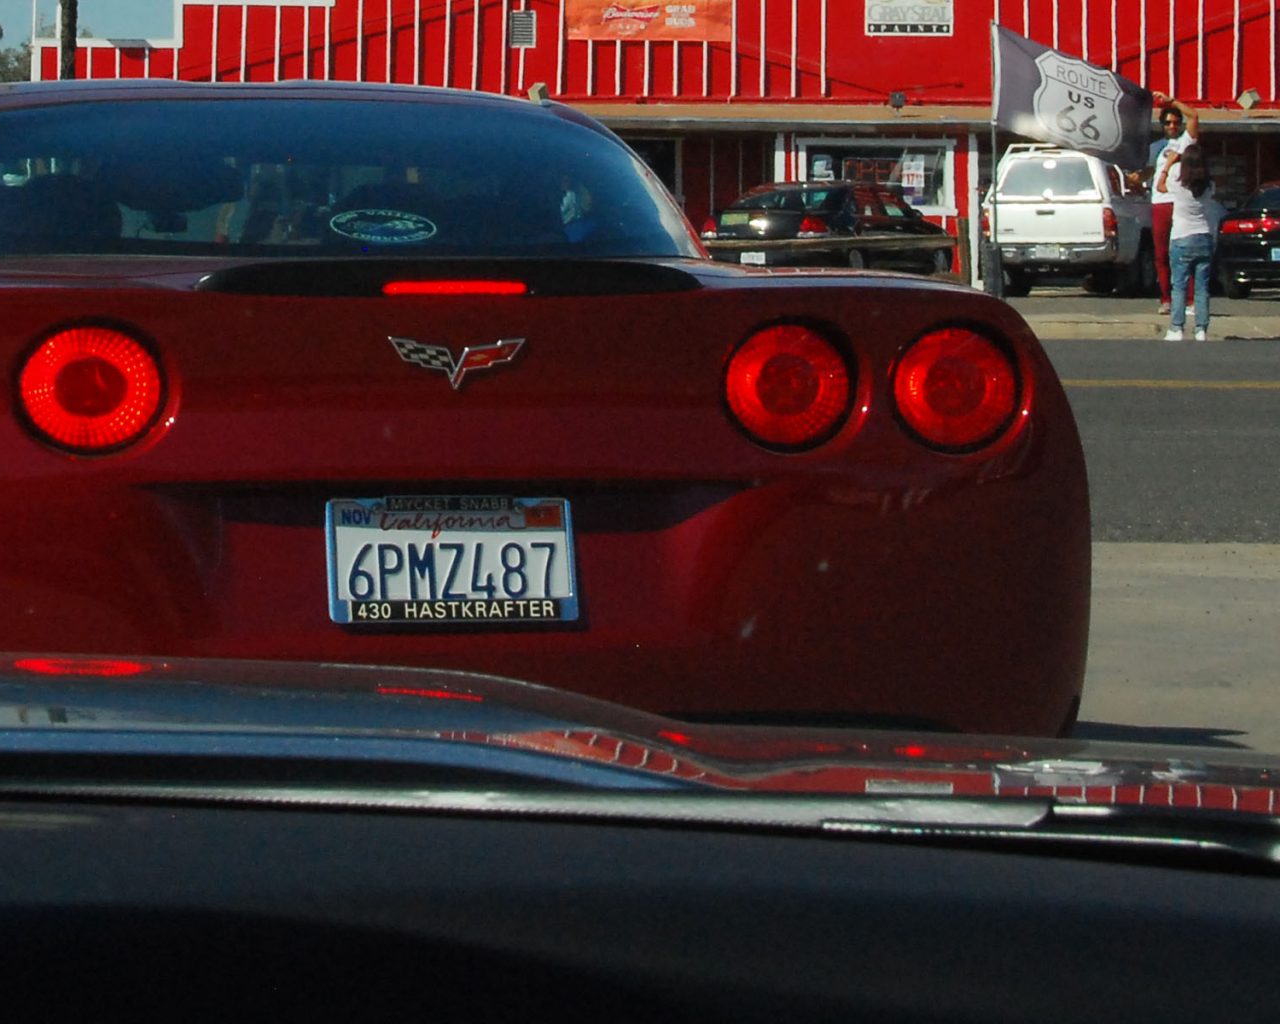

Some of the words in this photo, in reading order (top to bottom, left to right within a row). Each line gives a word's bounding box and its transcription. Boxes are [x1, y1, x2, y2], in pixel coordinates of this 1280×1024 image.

[880, 24, 939, 33] PAINT
[1056, 65, 1108, 95] ROUTE
[1067, 89, 1095, 109] US
[1056, 105, 1100, 141] 66
[390, 498, 449, 510] MYCKET
[459, 498, 509, 509] SNABB
[341, 509, 373, 525] NOV
[379, 510, 526, 539] California
[348, 542, 556, 600] 6PMZ487
[358, 603, 391, 619] 430
[405, 600, 554, 618] HASTKRAFTER
